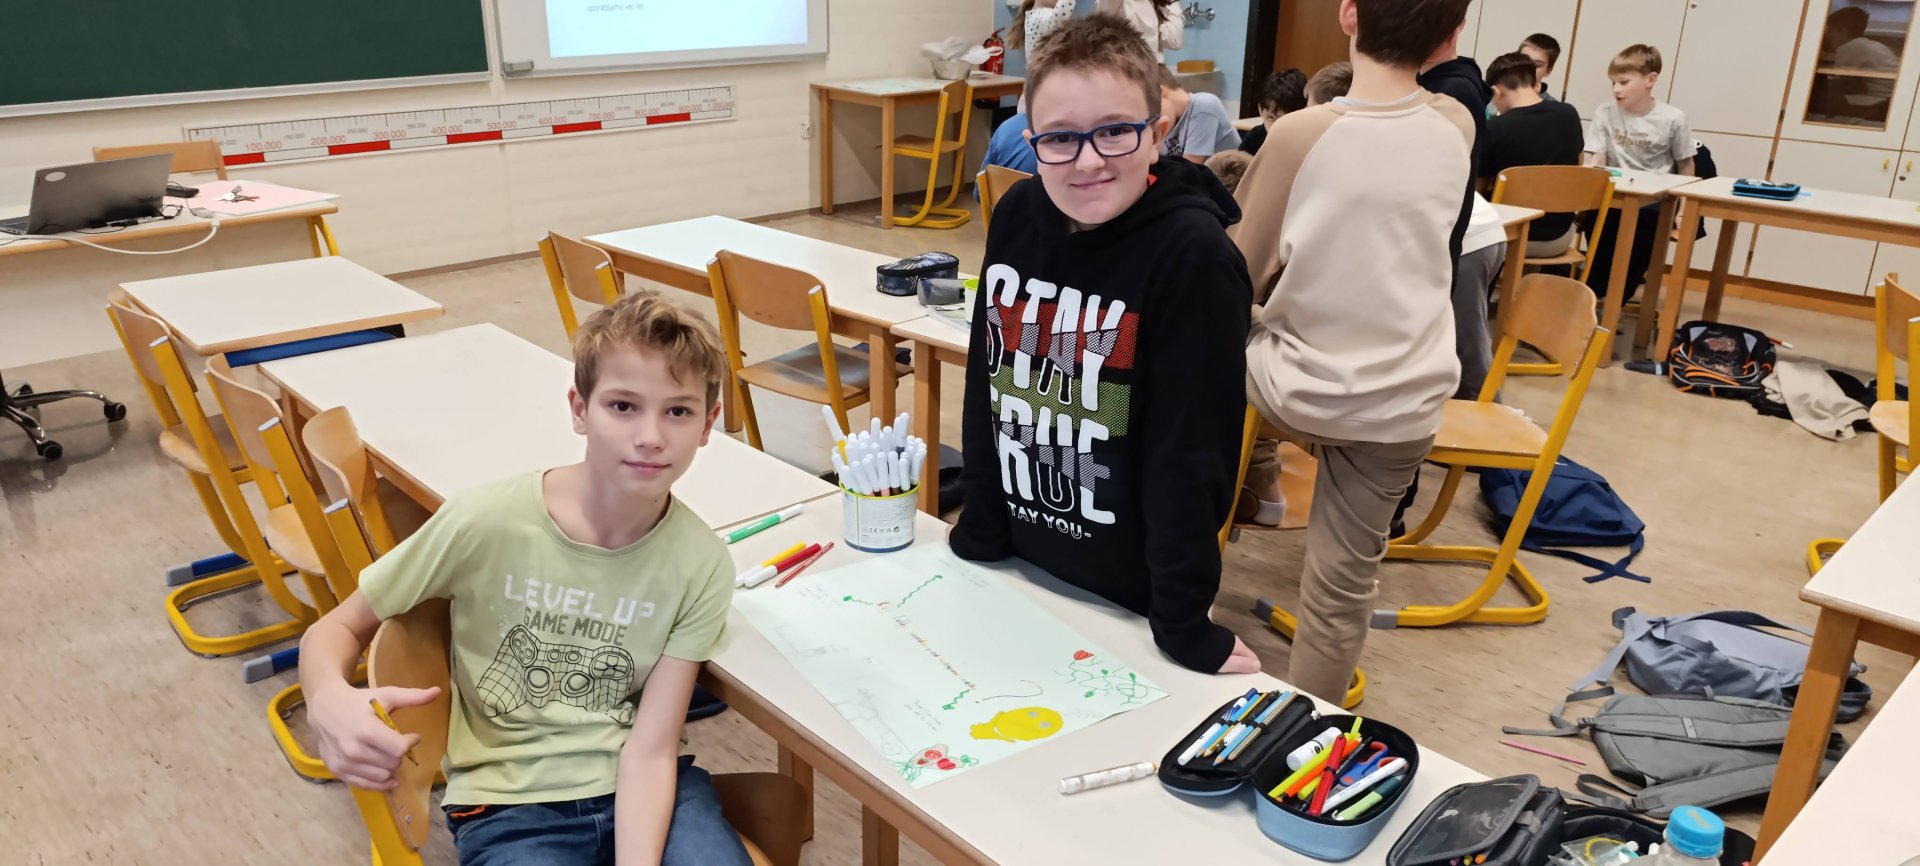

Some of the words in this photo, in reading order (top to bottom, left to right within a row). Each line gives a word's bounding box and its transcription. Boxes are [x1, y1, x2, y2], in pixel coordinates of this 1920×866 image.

[986, 263, 1126, 412] STAY
[504, 574, 602, 619] LEVEL
[613, 596, 656, 626] UP
[523, 606, 569, 637] GAME
[571, 615, 628, 647] MODE
